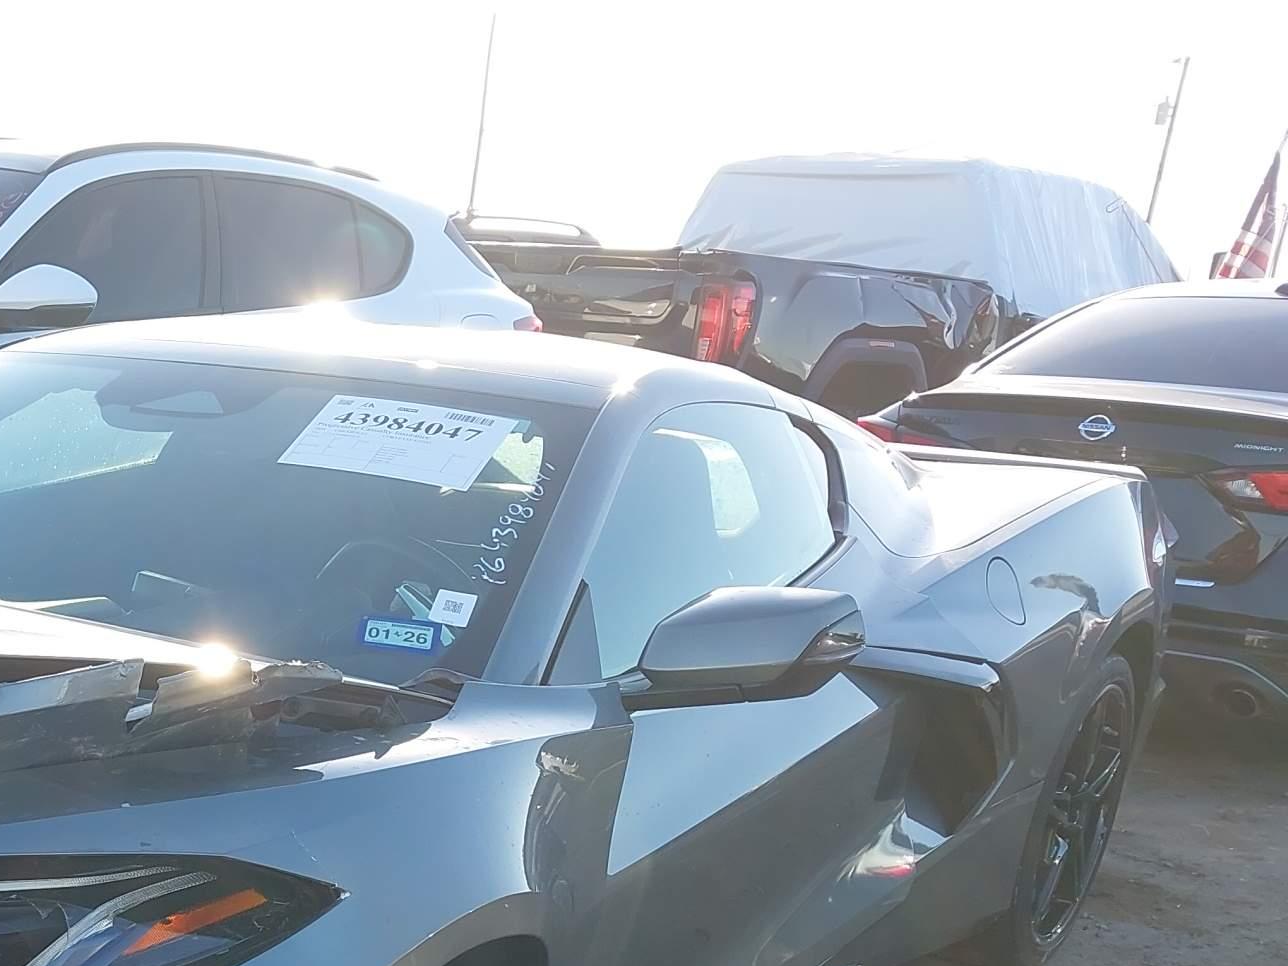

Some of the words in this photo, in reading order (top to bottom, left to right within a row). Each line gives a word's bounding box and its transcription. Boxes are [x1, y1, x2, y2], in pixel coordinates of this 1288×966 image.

[332, 411, 485, 442] 43984047
[367, 626, 391, 640] 01
[402, 630, 429, 645] 26
